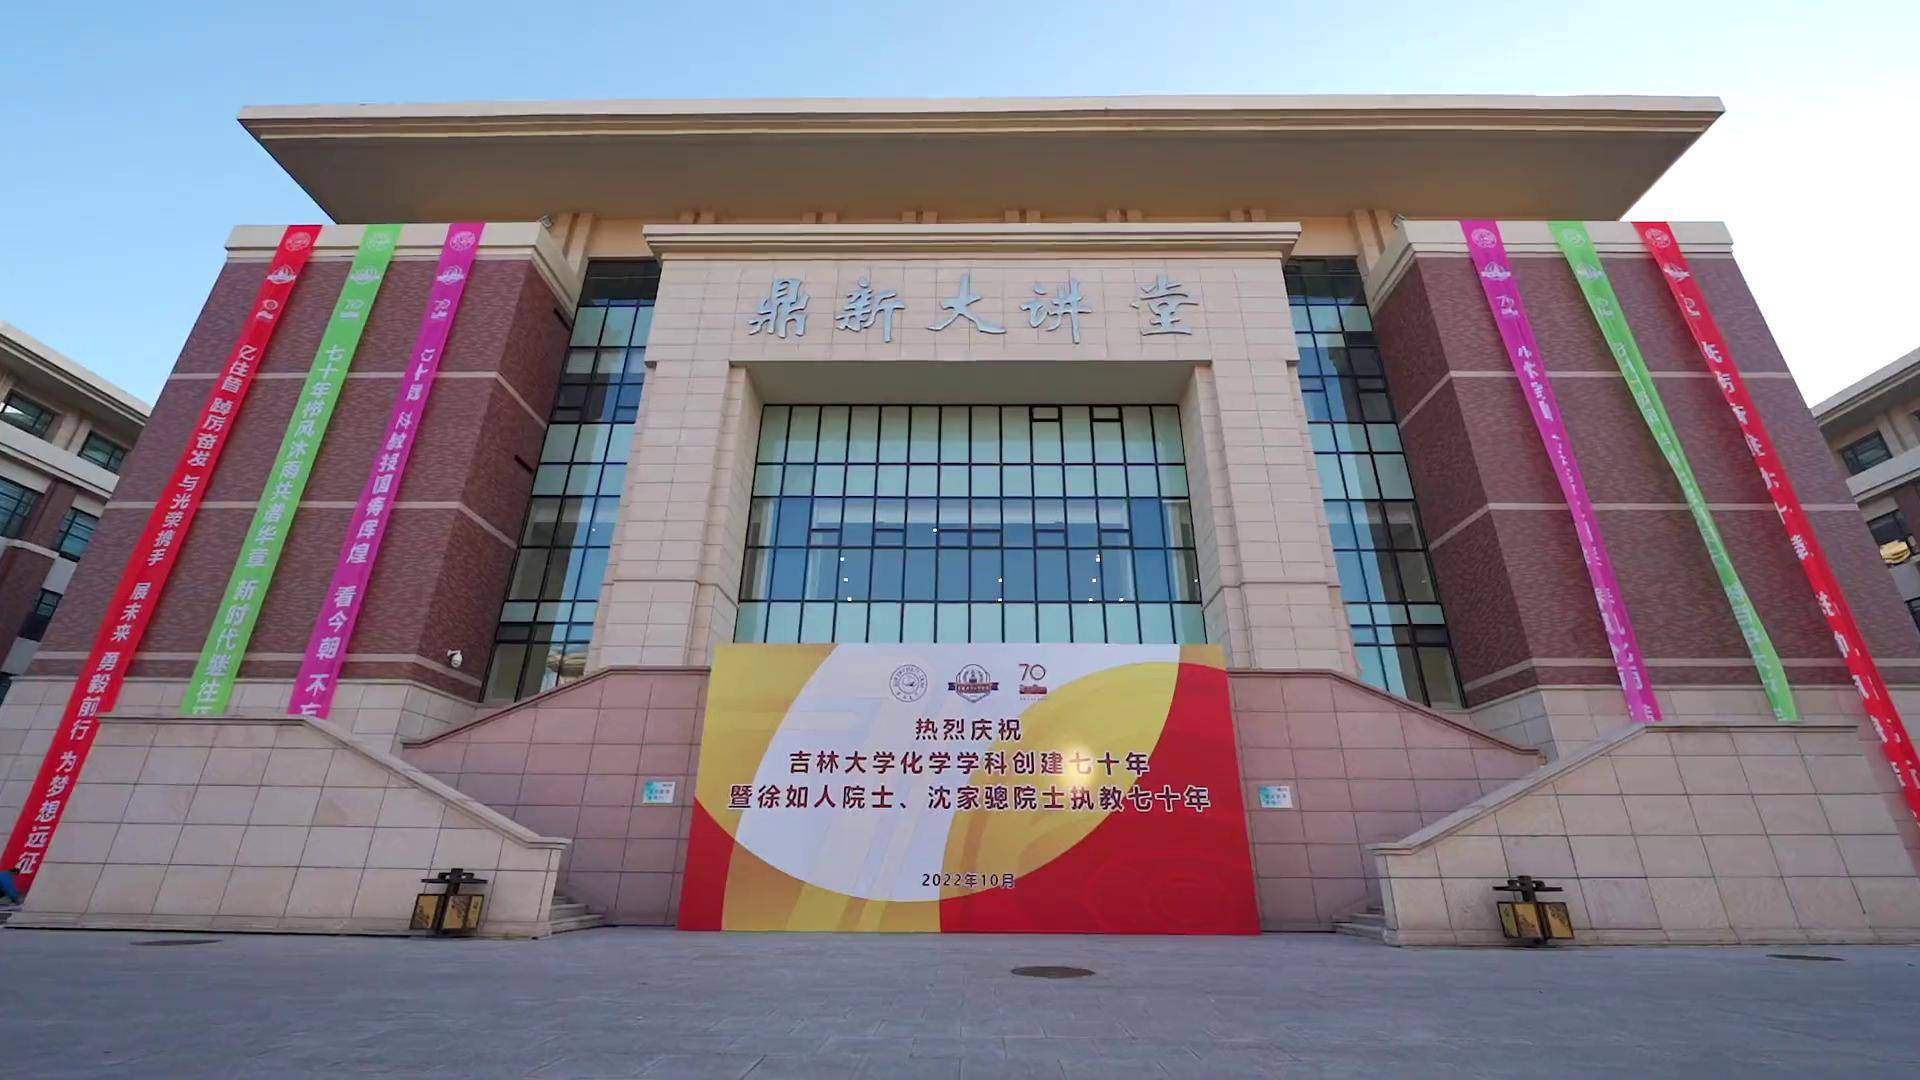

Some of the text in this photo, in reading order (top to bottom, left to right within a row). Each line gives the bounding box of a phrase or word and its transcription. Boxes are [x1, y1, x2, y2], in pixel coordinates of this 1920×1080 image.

[748, 273, 1198, 344] 鼎新大讲堂
[111, 582, 152, 642] 展未来
[316, 585, 357, 660] 看今朝
[1019, 663, 1046, 681] 70
[70, 652, 121, 740] 勇毅前行
[915, 718, 1021, 741] 热烈庆祝
[789, 752, 1150, 775] 吉林大学化学学科创建七十年
[16, 751, 78, 874] 为梦想远征
[729, 785, 1210, 811] 暨徐如人院士、沈家骢院士执教七十年
[922, 872, 1015, 888] 2022年10月
